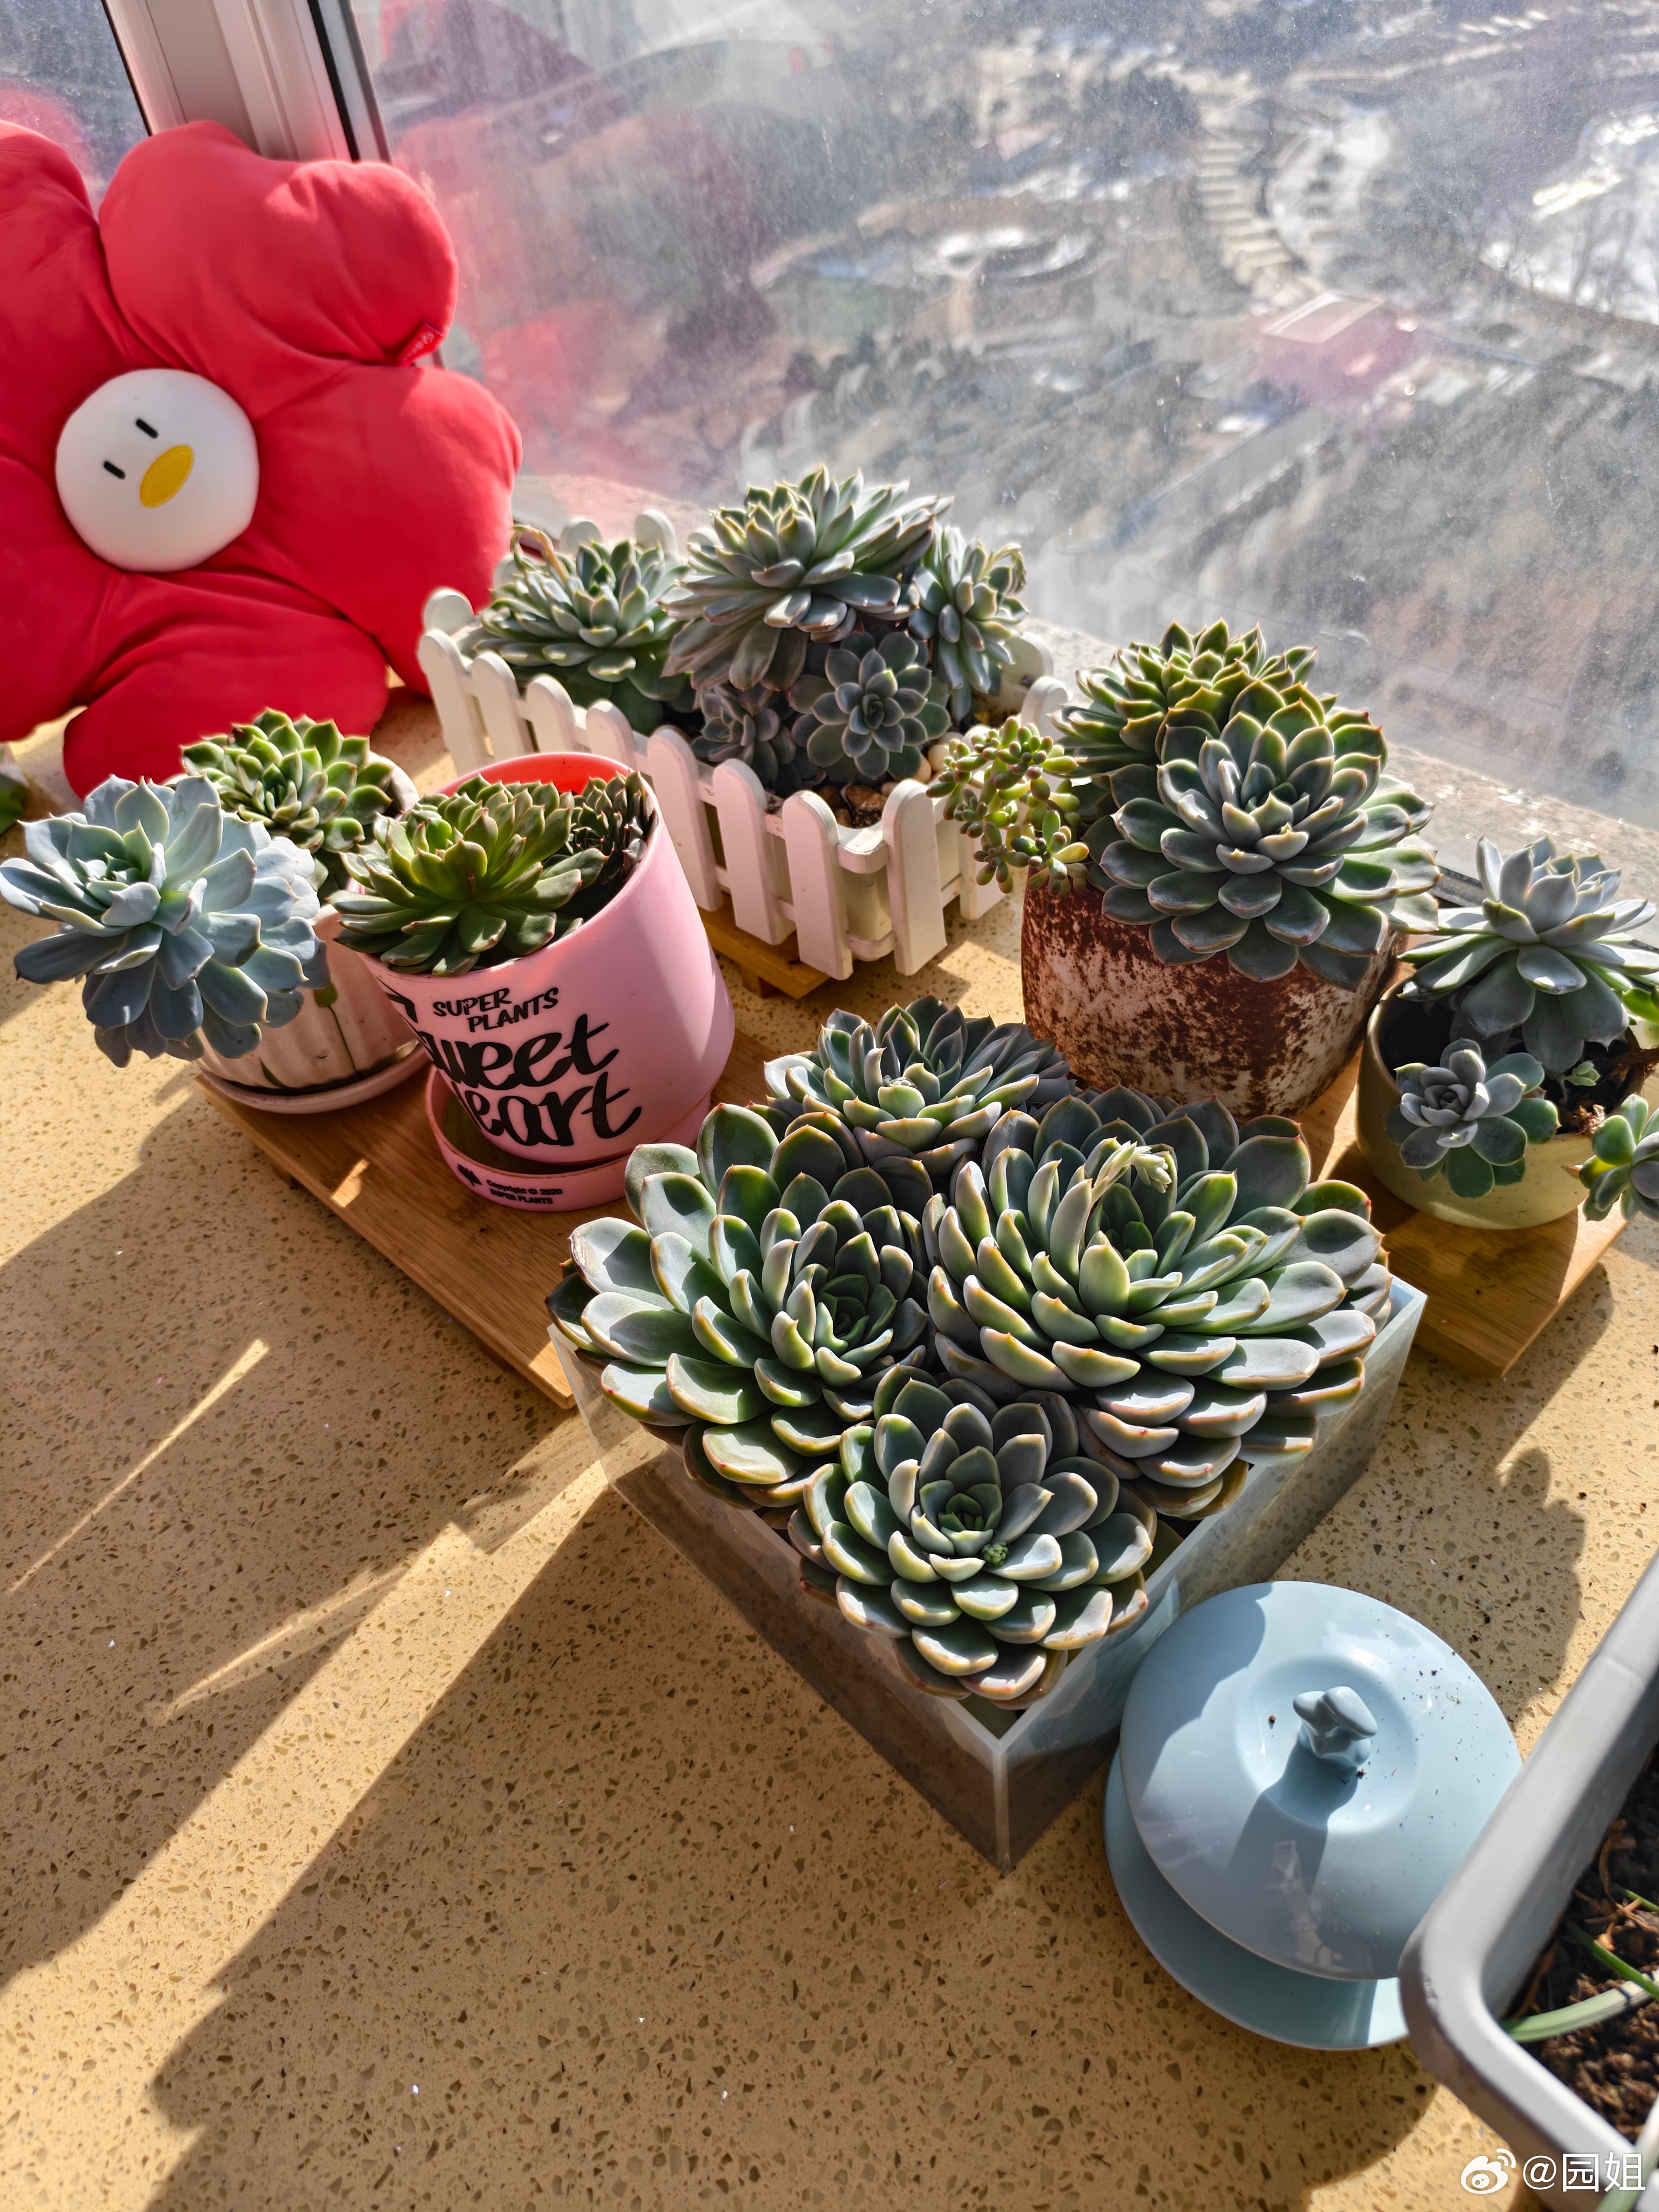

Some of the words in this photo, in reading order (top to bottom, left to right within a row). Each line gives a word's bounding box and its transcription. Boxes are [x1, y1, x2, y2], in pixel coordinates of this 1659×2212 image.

[433, 988, 512, 1017] SUPER
[467, 987, 559, 1033] PLANTS
[486, 1179, 527, 1195] Copyright
[489, 1188, 517, 1201] SUPER
[517, 1195, 554, 1204] PLANTS
